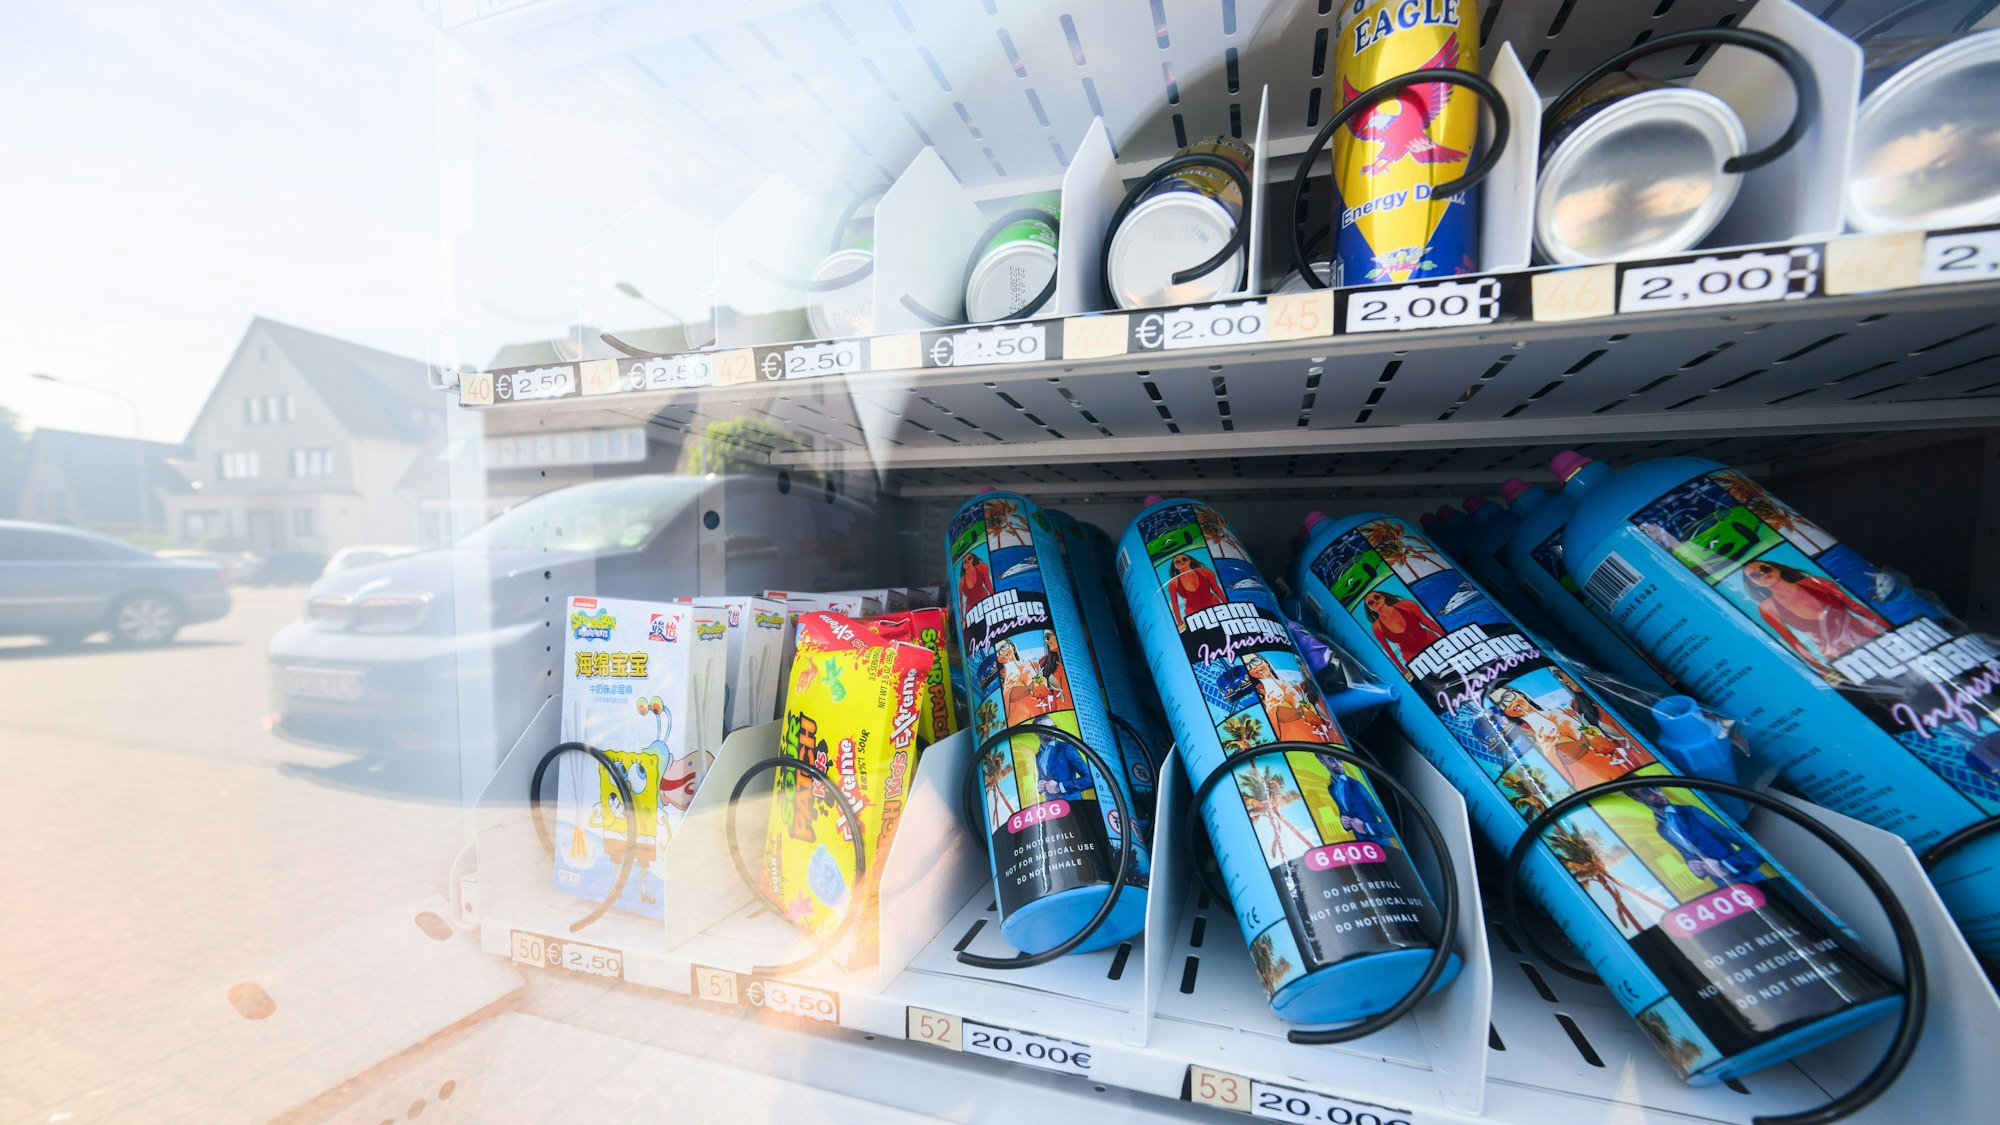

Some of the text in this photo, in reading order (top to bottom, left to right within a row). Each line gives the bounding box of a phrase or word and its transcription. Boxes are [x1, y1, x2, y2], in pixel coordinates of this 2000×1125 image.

[1353, 0, 1460, 56] EAGLE
[1342, 189, 1409, 230] Energy
[1640, 266, 1773, 301] 2,00
[1274, 299, 1320, 333] 45
[1361, 295, 1469, 323] 2,00
[1171, 314, 1261, 340] 2.00
[590, 364, 617, 385] 41
[652, 362, 709, 383] 2.50
[719, 357, 750, 381] 42
[790, 350, 854, 374] 2.50
[467, 378, 490, 400] 40
[518, 373, 568, 394] 2.50
[1635, 583, 1658, 604] E942
[969, 614, 1048, 658] Infusions
[1197, 634, 1292, 667] Infusions
[575, 651, 648, 678] 海绵宝宝
[880, 686, 888, 696] WT
[1436, 648, 1540, 717] Infusions
[877, 697, 886, 709] NET
[891, 667, 918, 748] Extreme
[856, 729, 871, 754] SOUR
[885, 750, 907, 799] Kids
[1013, 803, 1062, 829] 640G
[1014, 831, 1074, 857] DO NOT REFILL
[1314, 845, 1378, 867] 640G
[1005, 843, 1095, 878] NOT FOR MEDICAL USE
[1016, 858, 1082, 885] DO NOT INHALE
[1323, 880, 1401, 899] DO NOT REFILL
[1309, 896, 1423, 923] NOT FOR MEDICAL USE
[1675, 888, 1755, 932] 640G
[1335, 913, 1419, 934] DO NOT INHALE
[519, 939, 542, 961] 50
[1703, 925, 1800, 970] DO NOT REFILL
[569, 951, 620, 973] 2,50
[1697, 938, 1840, 1000] NOT FOR MEDICAL USE
[709, 974, 732, 998] 51
[1736, 962, 1842, 1010] DO NOT INHALE
[771, 989, 834, 1016] 3,50
[920, 1015, 951, 1043] 52
[971, 1031, 1092, 1069] 20.00€
[1200, 1073, 1239, 1104] 53
